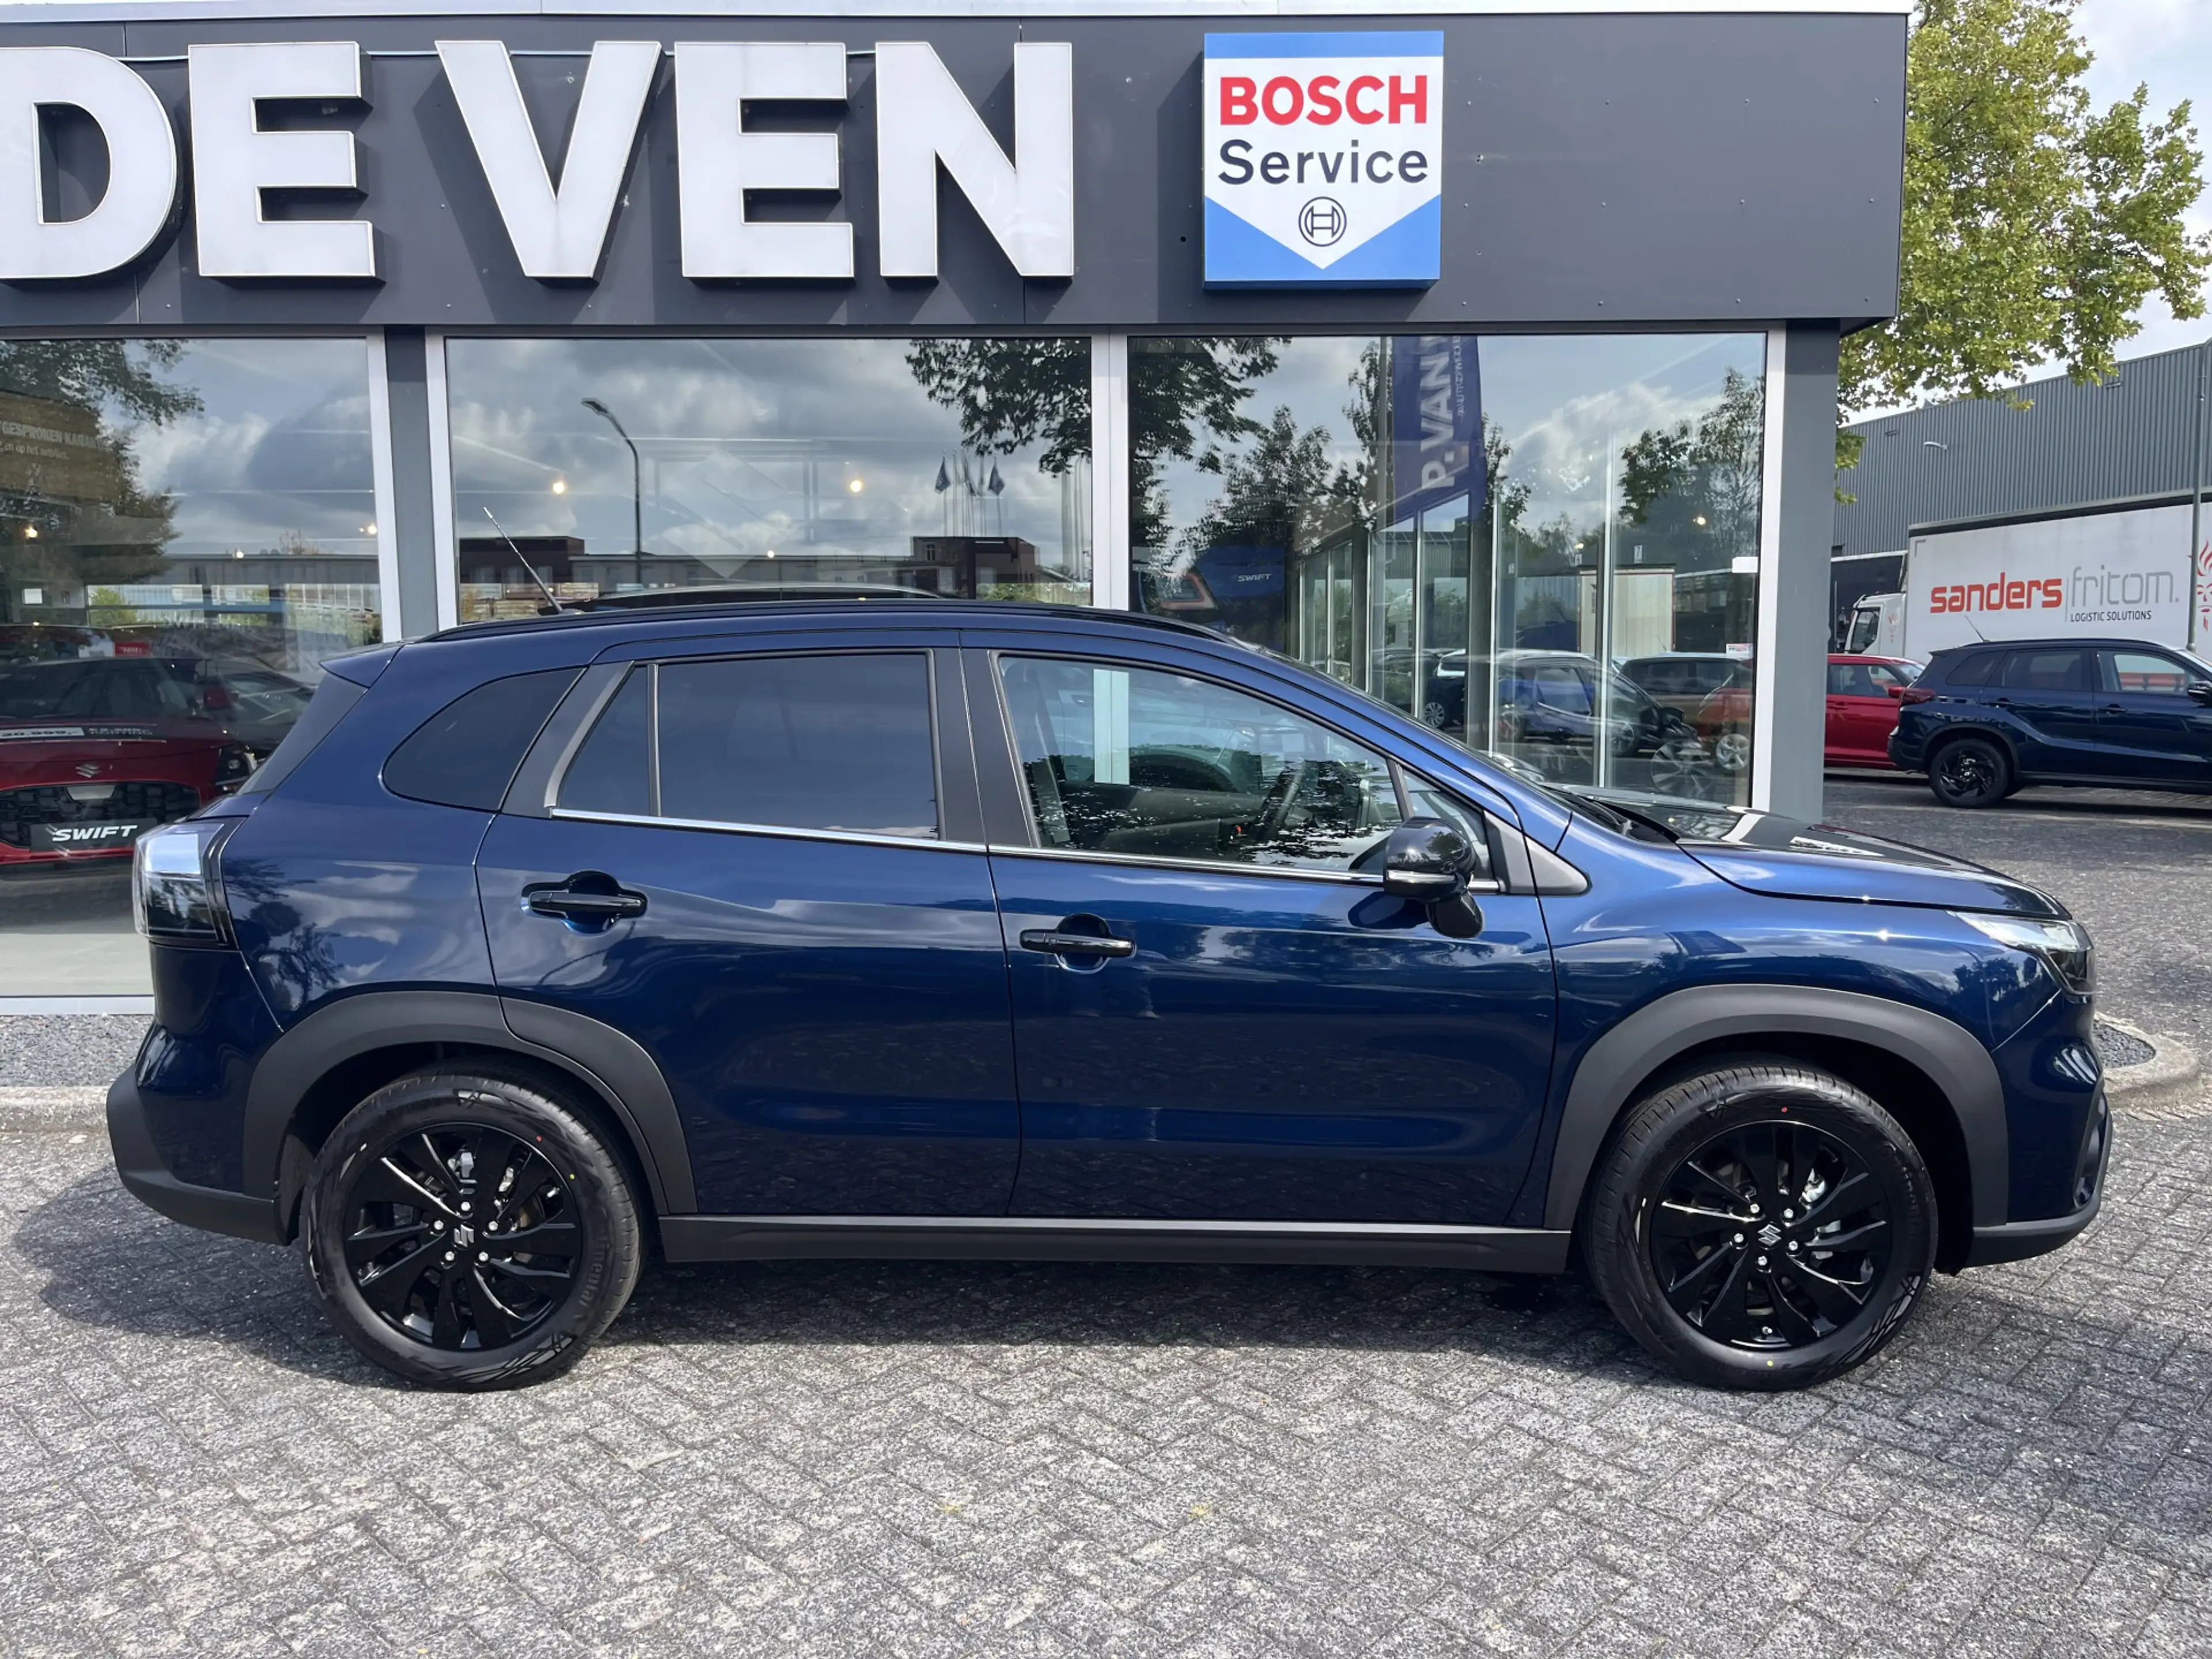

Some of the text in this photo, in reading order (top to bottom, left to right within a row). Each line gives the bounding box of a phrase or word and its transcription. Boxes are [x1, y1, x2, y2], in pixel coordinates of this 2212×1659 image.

[1220, 75, 1427, 126] BOSCH
[0, 40, 1073, 279] DE VEN
[1218, 139, 1428, 185] Service
[1237, 574, 1272, 582] SWIFT
[1930, 572, 2062, 613] sanders
[2070, 610, 2152, 622] LOGISTIC SOLUTIONS
[52, 825, 138, 842] SWIFT
[578, 1205, 607, 1307] ntinental
